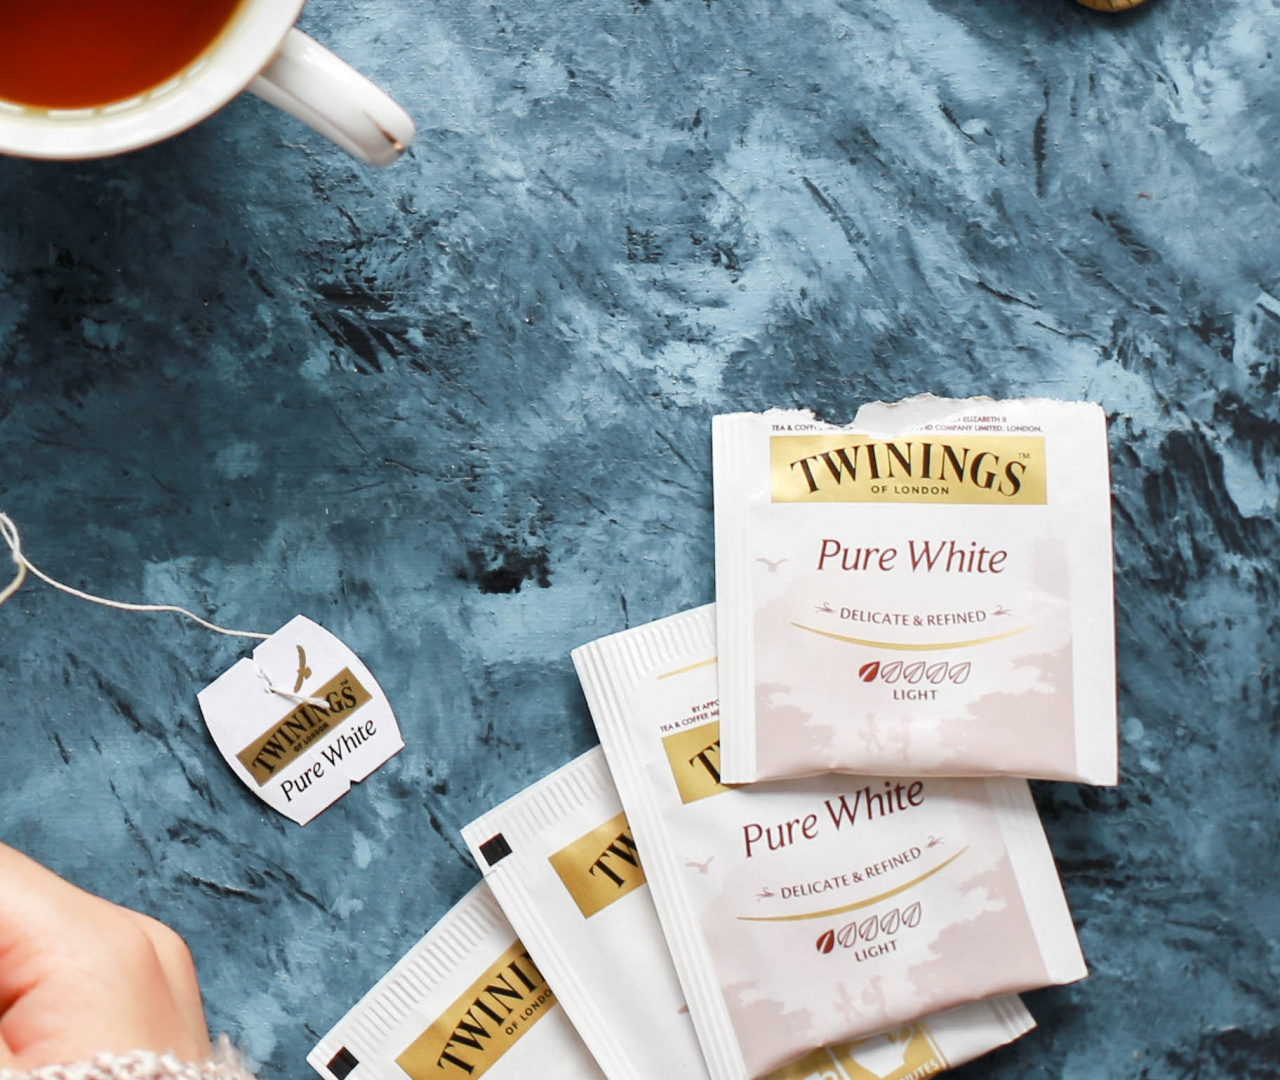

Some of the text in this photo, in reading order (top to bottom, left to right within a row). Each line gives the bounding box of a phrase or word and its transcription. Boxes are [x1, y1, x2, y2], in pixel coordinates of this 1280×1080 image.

[790, 442, 1028, 497] TWININGS
[871, 485, 950, 495] OF LONDON
[816, 538, 1009, 574] Pure White
[840, 607, 987, 626] DELICATE & REFINED
[893, 689, 938, 700] LIGHT
[660, 723, 674, 733] TEA
[293, 742, 304, 752] OF
[280, 719, 377, 802] Pure White
[742, 780, 925, 858] Pure White
[781, 846, 921, 899] DELICATE & REFINED
[854, 939, 898, 963] LIGHT
[437, 952, 546, 1075] TWINI
[505, 1021, 520, 1036] OF
